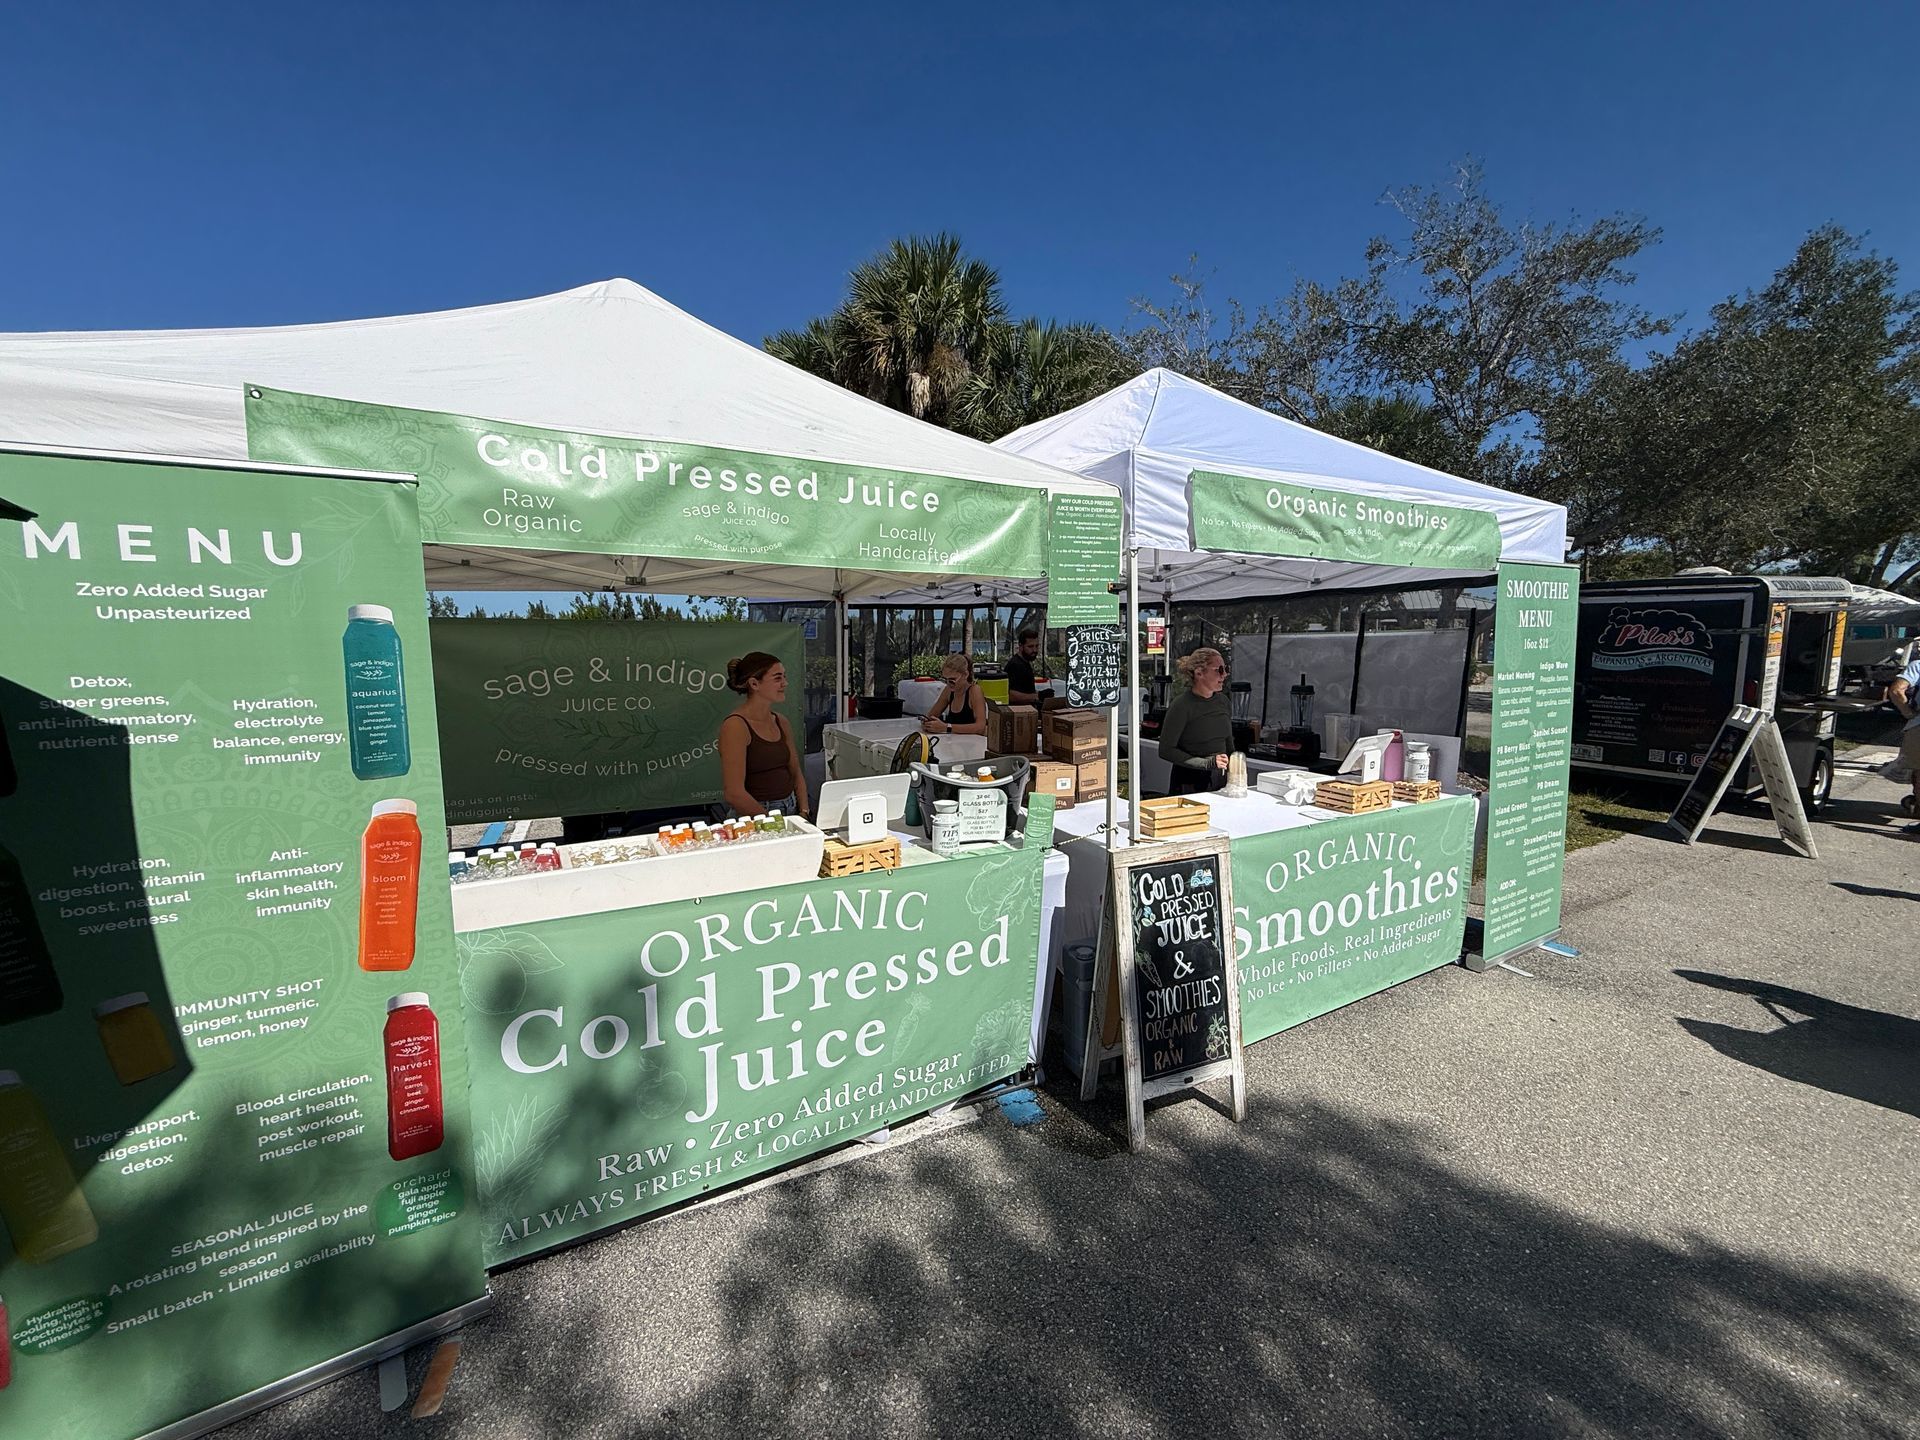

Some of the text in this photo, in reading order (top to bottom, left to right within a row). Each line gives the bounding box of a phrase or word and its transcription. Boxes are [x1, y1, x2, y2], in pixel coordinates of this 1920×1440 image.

[477, 434, 940, 513] Cold Pressed Juice
[503, 489, 555, 510] Raw
[1266, 488, 1448, 531] Organic Smoothies
[483, 509, 582, 533] Organic
[682, 502, 789, 525] sage & indigo
[22, 520, 302, 566] MENU
[879, 523, 936, 544] Locally
[76, 582, 268, 601] Zero Added Sugar
[1507, 580, 1569, 599] SMOOTHIE
[96, 605, 251, 621] Unpasteurized
[1519, 610, 1552, 627] MENU
[1081, 632, 1109, 641] PRICES
[1524, 638, 1538, 650] 16oz
[1616, 624, 1695, 646] Pilar's
[1593, 654, 1713, 667] EMPANADAS ARGENTINAS
[70, 675, 132, 689] Detox,
[483, 656, 726, 700] sage & indigo
[1498, 671, 1535, 680] Market Morning
[39, 693, 170, 711] super greens,
[233, 696, 318, 711] Hydration,
[352, 689, 397, 697] aquarius
[561, 696, 656, 713] JUICE CO.
[18, 711, 197, 731] anti-inflammatory,
[234, 714, 323, 730] electrolyte
[39, 731, 179, 750] nutrient dense
[212, 730, 346, 749] balance, energy,
[244, 749, 321, 766] immunity
[495, 738, 719, 777] pressed with purpose
[72, 856, 171, 879] Hydration,
[270, 849, 309, 862] Anti-
[1265, 832, 1417, 894] ORGANIC
[235, 861, 344, 884] inflammatory
[373, 875, 406, 883] bloom
[38, 870, 205, 902] digestion, vitamin
[246, 878, 338, 901] skin health,
[60, 891, 191, 919] boost, natural
[256, 897, 332, 920] immunity
[1161, 890, 1214, 918] PRESSED
[1233, 859, 1459, 961] Smoothies
[78, 911, 178, 936] sweetness
[640, 889, 929, 978] ORGANIC
[1156, 912, 1212, 947] JUICE
[1291, 943, 1340, 970] Foods.
[1344, 932, 1376, 952] Real
[1379, 909, 1452, 943] Ingredients
[1173, 949, 1195, 979] &
[1247, 927, 1442, 1003] No Ice No Fillers No Added Sugar
[175, 979, 324, 1016] IMMUNITY SHOT
[500, 914, 1010, 1073] Cold Pressed
[1146, 976, 1222, 1019] SMOOTHIES
[182, 997, 320, 1036] ginger, turmeric,
[1146, 1012, 1199, 1041] ORGANIC
[196, 1015, 309, 1048] lemon, honey
[393, 1059, 432, 1072] harvest
[685, 1016, 886, 1123] Juice
[1154, 1047, 1184, 1070] RAW
[235, 1071, 373, 1116] Blood circulation,
[259, 1092, 358, 1127] heart health,
[598, 1053, 963, 1182] Raw Zero Added Sugar
[73, 1110, 201, 1151] Liver support,
[258, 1108, 364, 1147] post workout,
[98, 1132, 188, 1163] digestion,
[259, 1123, 366, 1163] muscle repair
[499, 1053, 1011, 1246] ALWAYS FRESH & LOCALLY HANDCRAFTED
[121, 1152, 174, 1176] detox
[393, 1169, 451, 1190] orchard
[398, 1180, 448, 1199] gala apple
[401, 1189, 445, 1206] fuji apple
[406, 1199, 440, 1213] orange
[388, 1210, 457, 1236] pumpkin spice
[407, 1207, 438, 1222] ginger
[171, 1203, 314, 1258] SEASONAL JUICE
[109, 1204, 368, 1296] A rotating blend inspired by the
[219, 1251, 278, 1279] season
[107, 1234, 376, 1335] Small batch Limited availability
